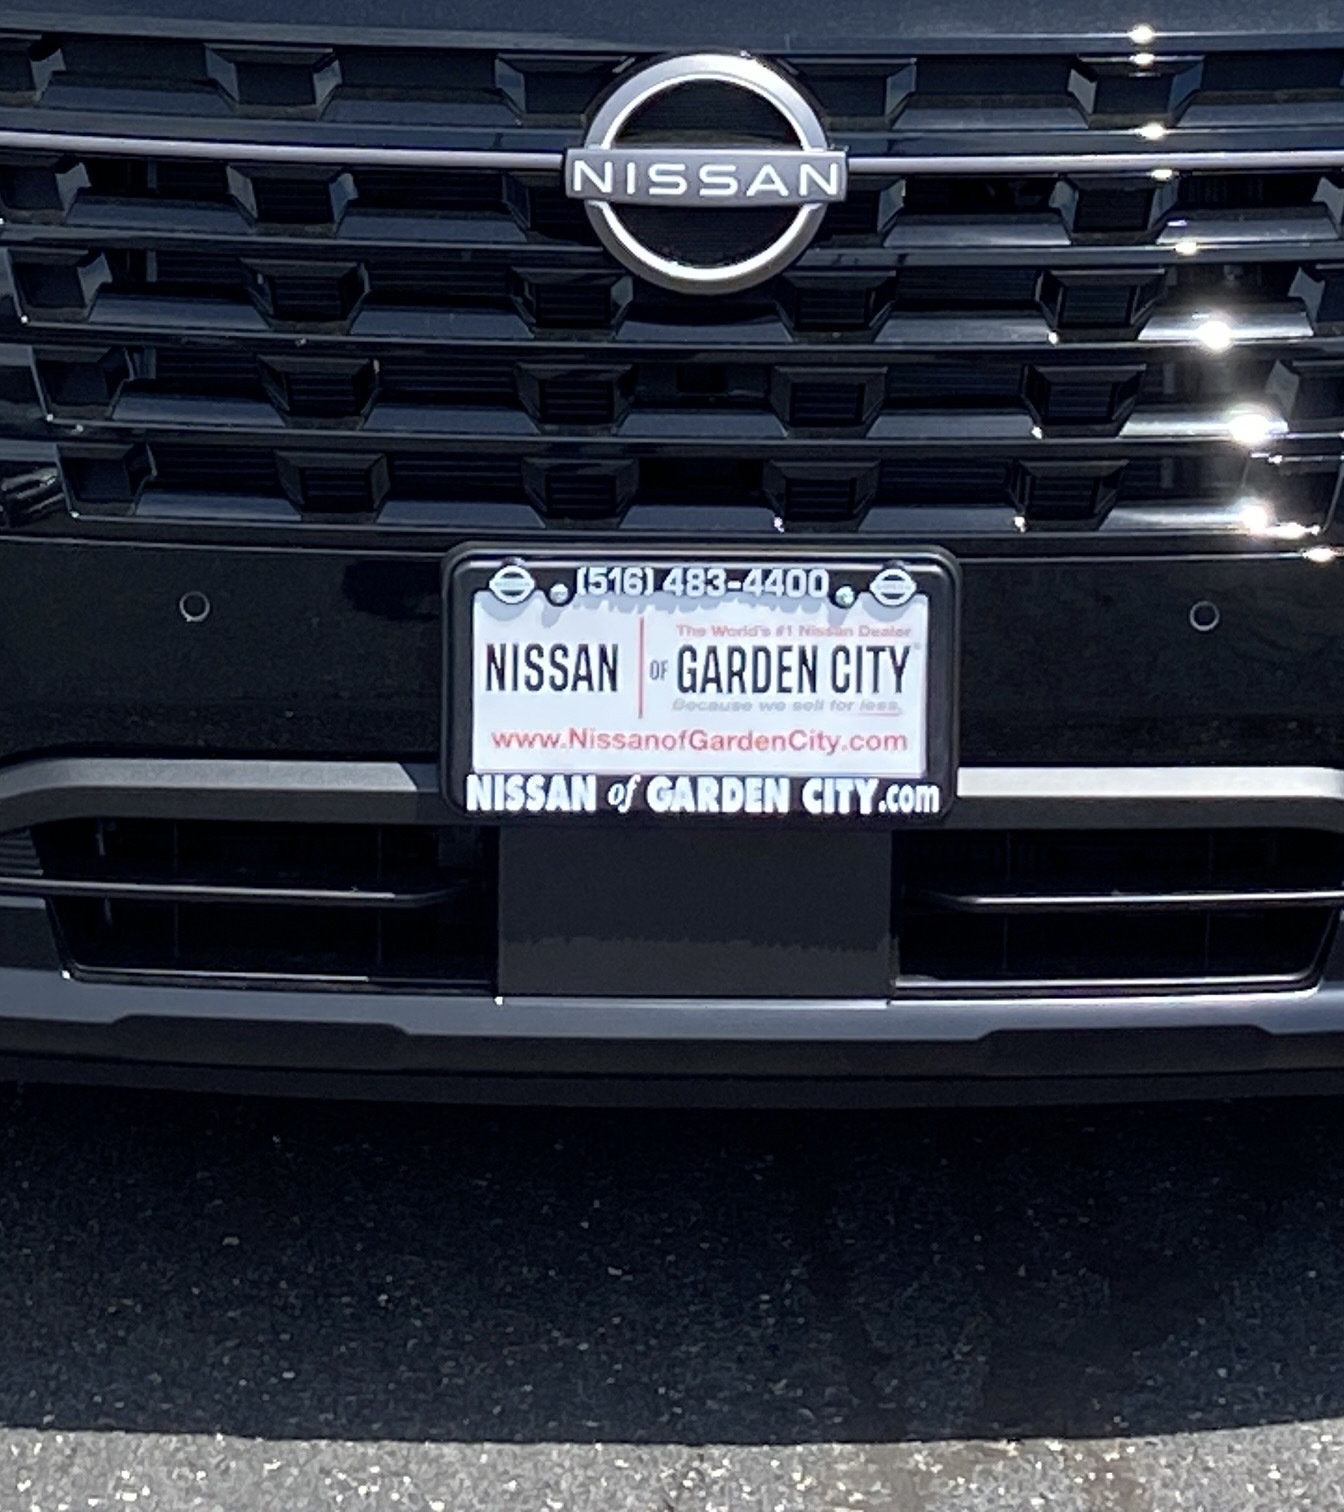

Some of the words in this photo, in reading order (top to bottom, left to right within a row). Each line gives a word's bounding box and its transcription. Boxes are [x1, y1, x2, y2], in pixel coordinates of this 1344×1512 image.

[572, 159, 839, 198] NISSAN
[575, 566, 654, 597] (516)
[662, 566, 830, 599] 483-4400
[676, 624, 707, 638] The
[711, 624, 772, 638] World's
[775, 624, 794, 638] #1
[798, 625, 854, 638] Nissan
[858, 625, 913, 639] Dealer
[485, 642, 619, 693] NISSAN
[649, 660, 669, 681] OF
[676, 644, 818, 694] GARDEN
[830, 645, 911, 695] CITY
[671, 697, 754, 713] Because
[759, 700, 786, 713] we
[792, 698, 825, 713] sell
[829, 698, 856, 713] for
[491, 727, 908, 755] www.NissanofGardenCity.com
[465, 774, 597, 812] NISSAN
[607, 775, 641, 813] of
[646, 775, 790, 813] GARDEN
[802, 777, 940, 815] CITY.com
